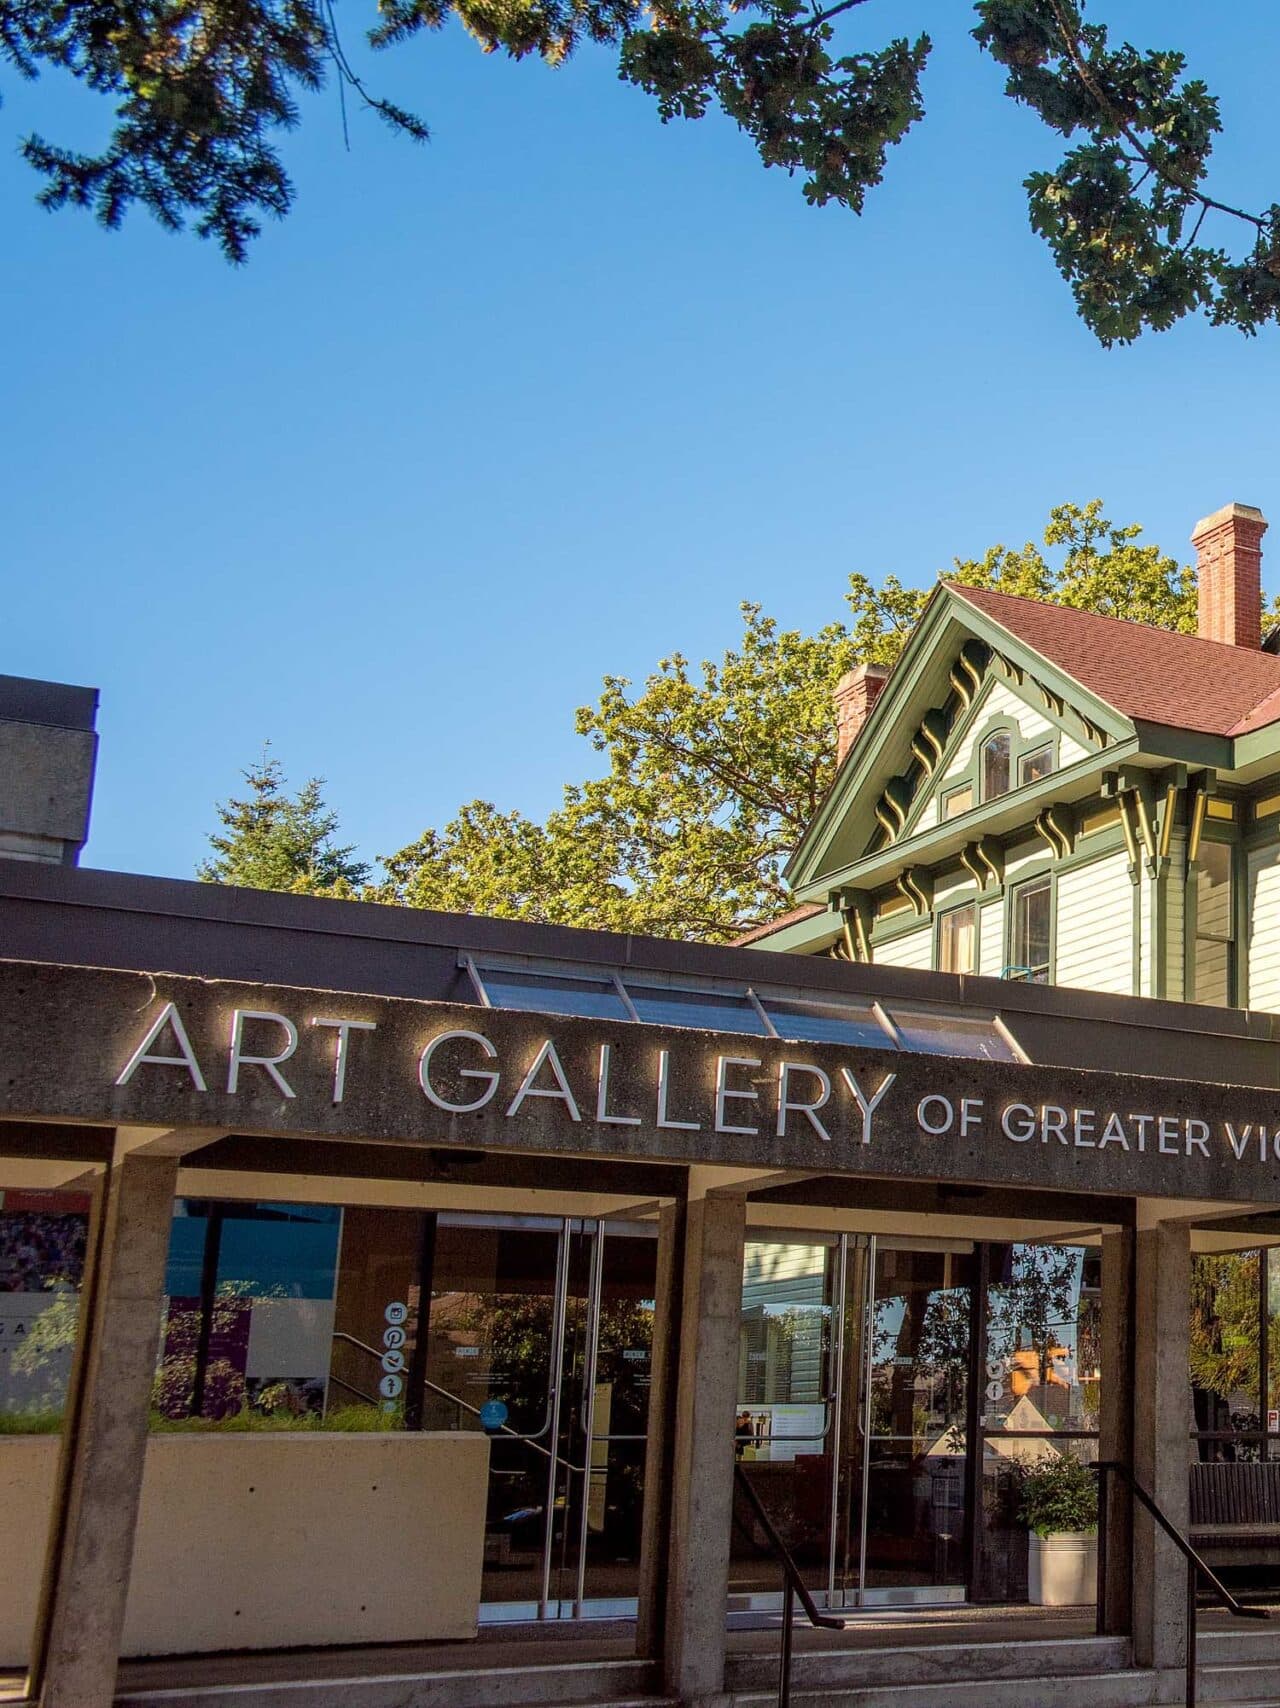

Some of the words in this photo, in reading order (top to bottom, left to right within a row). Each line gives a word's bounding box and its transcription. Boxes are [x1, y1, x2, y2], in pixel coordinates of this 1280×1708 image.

[115, 1001, 378, 1104] ART
[418, 1029, 898, 1146] GALLERY
[916, 1092, 983, 1138] OF
[1001, 1102, 1212, 1158] GREATER
